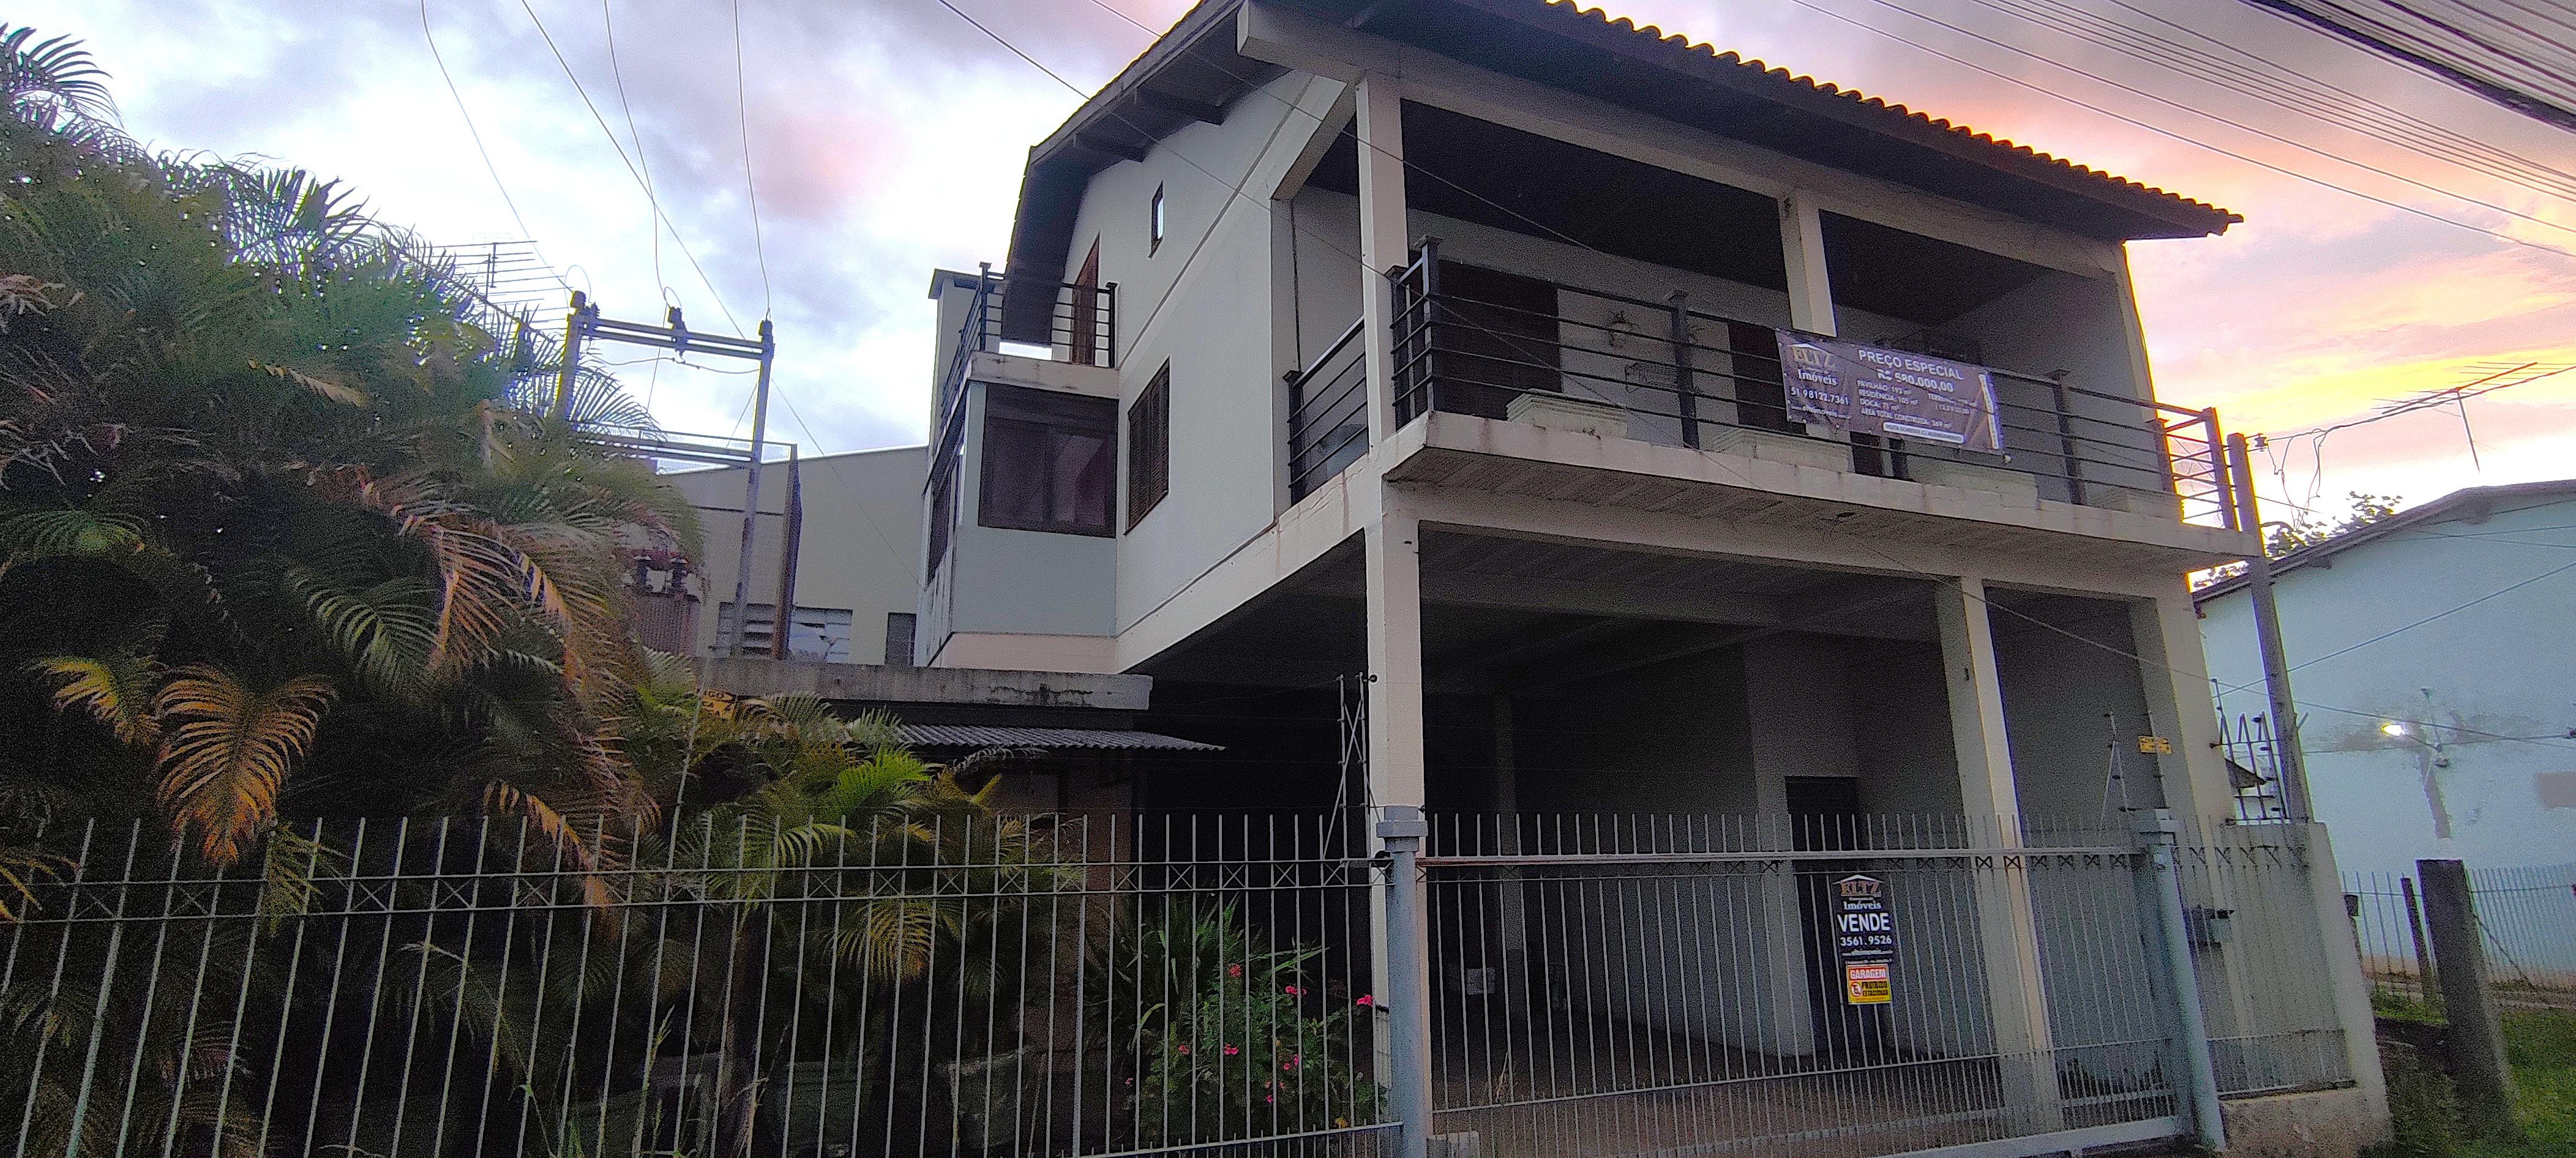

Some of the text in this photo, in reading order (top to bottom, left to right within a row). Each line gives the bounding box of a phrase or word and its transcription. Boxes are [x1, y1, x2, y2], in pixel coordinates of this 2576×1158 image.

[1858, 349, 1965, 380] PREÇO ESPECIAL
[1798, 368, 1838, 386] Imóveis
[1791, 387, 1849, 405] 51 98122.7361
[1841, 881, 1881, 896] ELTZ
[1844, 900, 1882, 910] Imóveis
[1837, 913, 1891, 933] VENDE
[1840, 935, 1892, 947] 3561.9526
[1851, 968, 1887, 979] GARAGEM
